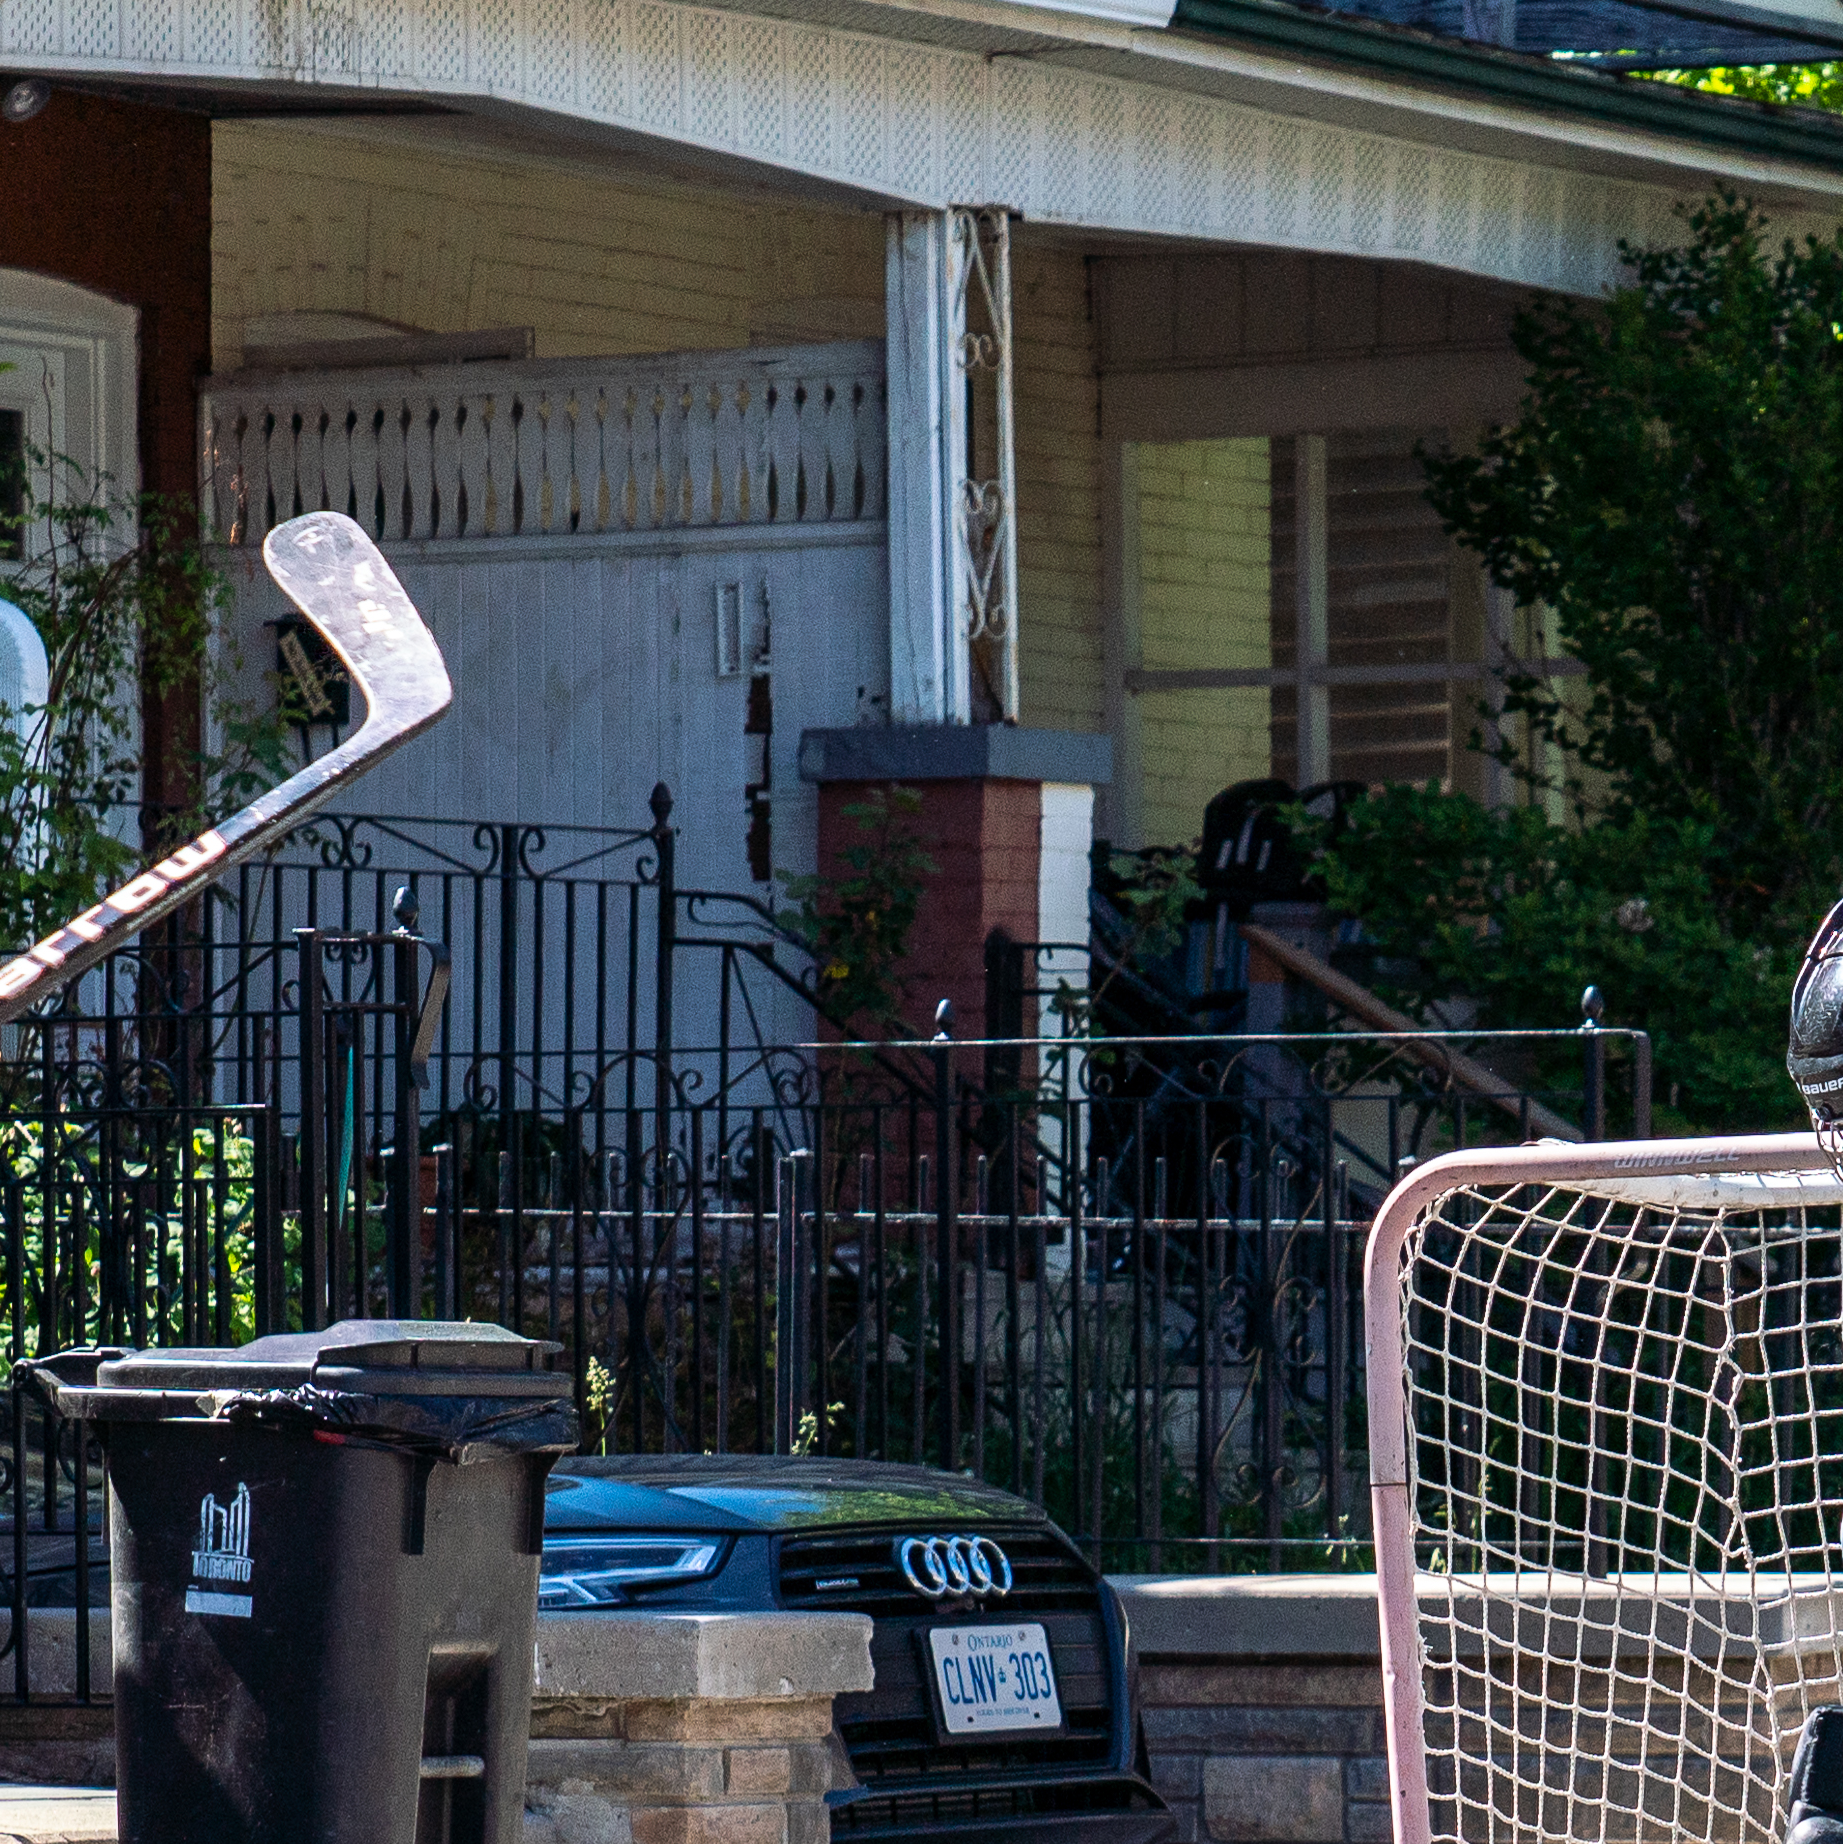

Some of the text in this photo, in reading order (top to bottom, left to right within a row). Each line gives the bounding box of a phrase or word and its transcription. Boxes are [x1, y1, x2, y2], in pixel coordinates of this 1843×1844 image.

[191, 1551, 255, 1583] TORONTO
[967, 1633, 1013, 1651] ONTARIO
[943, 1651, 1051, 1704] CLNV 303
